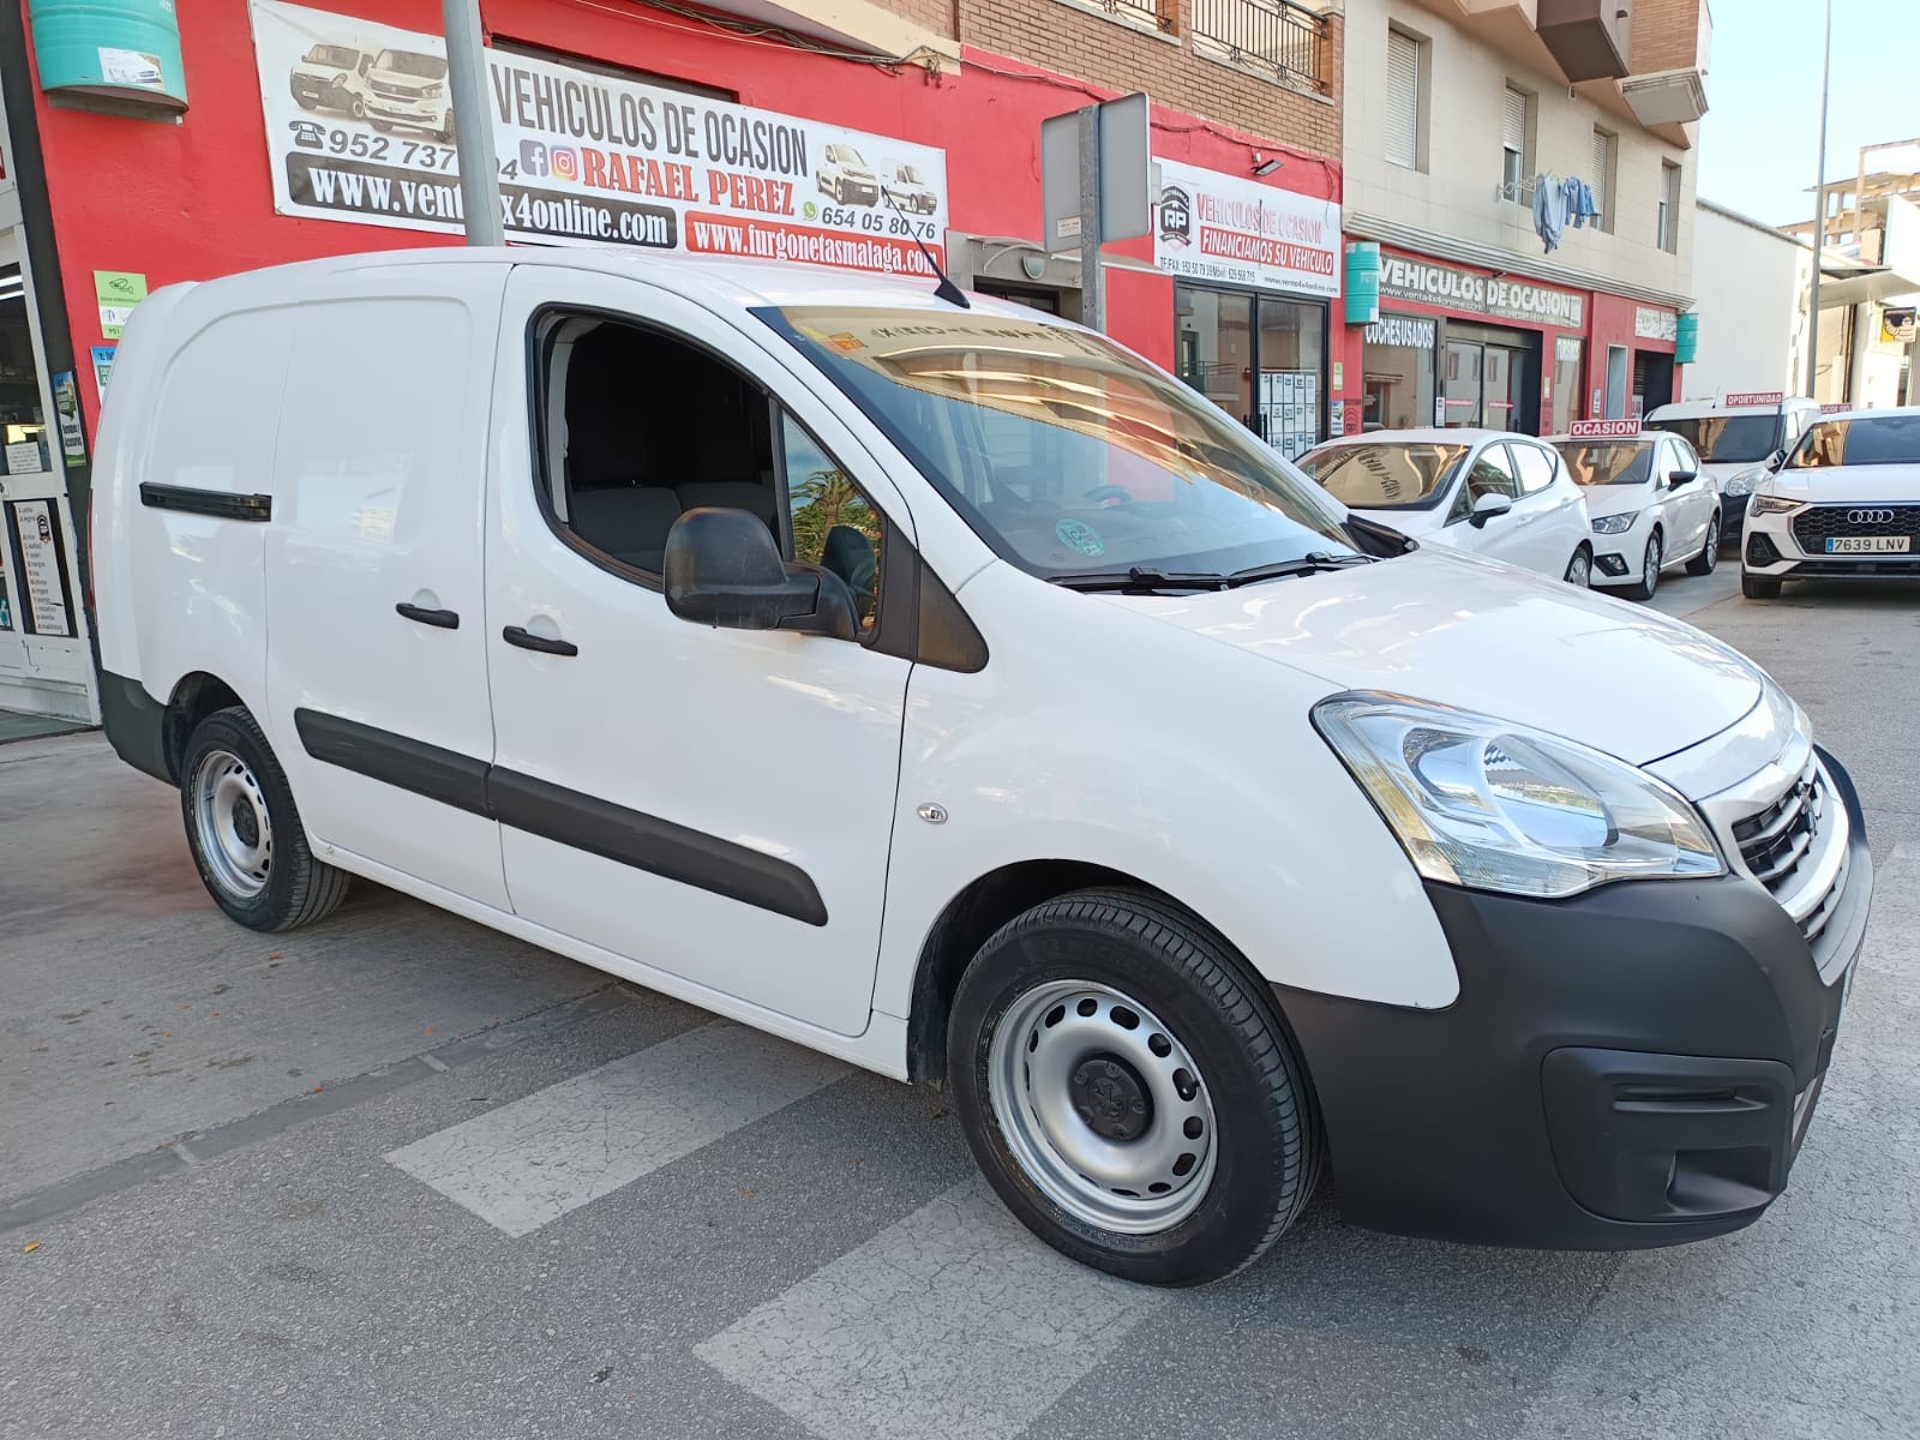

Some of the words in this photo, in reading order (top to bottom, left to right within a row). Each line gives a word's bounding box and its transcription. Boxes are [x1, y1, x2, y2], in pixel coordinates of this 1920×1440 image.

[491, 63, 657, 152] VEHICULOS
[663, 101, 699, 158] DE
[705, 110, 808, 177] OCASION
[328, 129, 390, 161] 952
[402, 141, 456, 171] 737
[581, 147, 699, 202] RAFAEL
[707, 168, 795, 216] PEREZ
[308, 167, 668, 245] www.ventx4online.com
[822, 206, 856, 229] 654
[861, 213, 883, 233] 05
[916, 221, 936, 240] 76
[1197, 192, 1260, 230] VEHICULOS
[1262, 207, 1276, 234] DE
[1278, 213, 1321, 244] OCASION
[693, 219, 938, 276] www.furgonetasmalaga.com
[1201, 231, 1273, 262] FINANCIAMOS
[1275, 244, 1288, 266] SU
[1289, 247, 1333, 275] VEHICULO
[1379, 256, 1484, 301] VEHICULOS
[1487, 280, 1507, 307] DE
[1510, 284, 1571, 318] OCASION
[1401, 319, 1435, 349] USADOS
[1728, 393, 1782, 405] OPORTUNIDAD
[1572, 422, 1637, 435] OCASION
[1835, 539, 1872, 551] 7639
[1876, 538, 1905, 550] LNV
